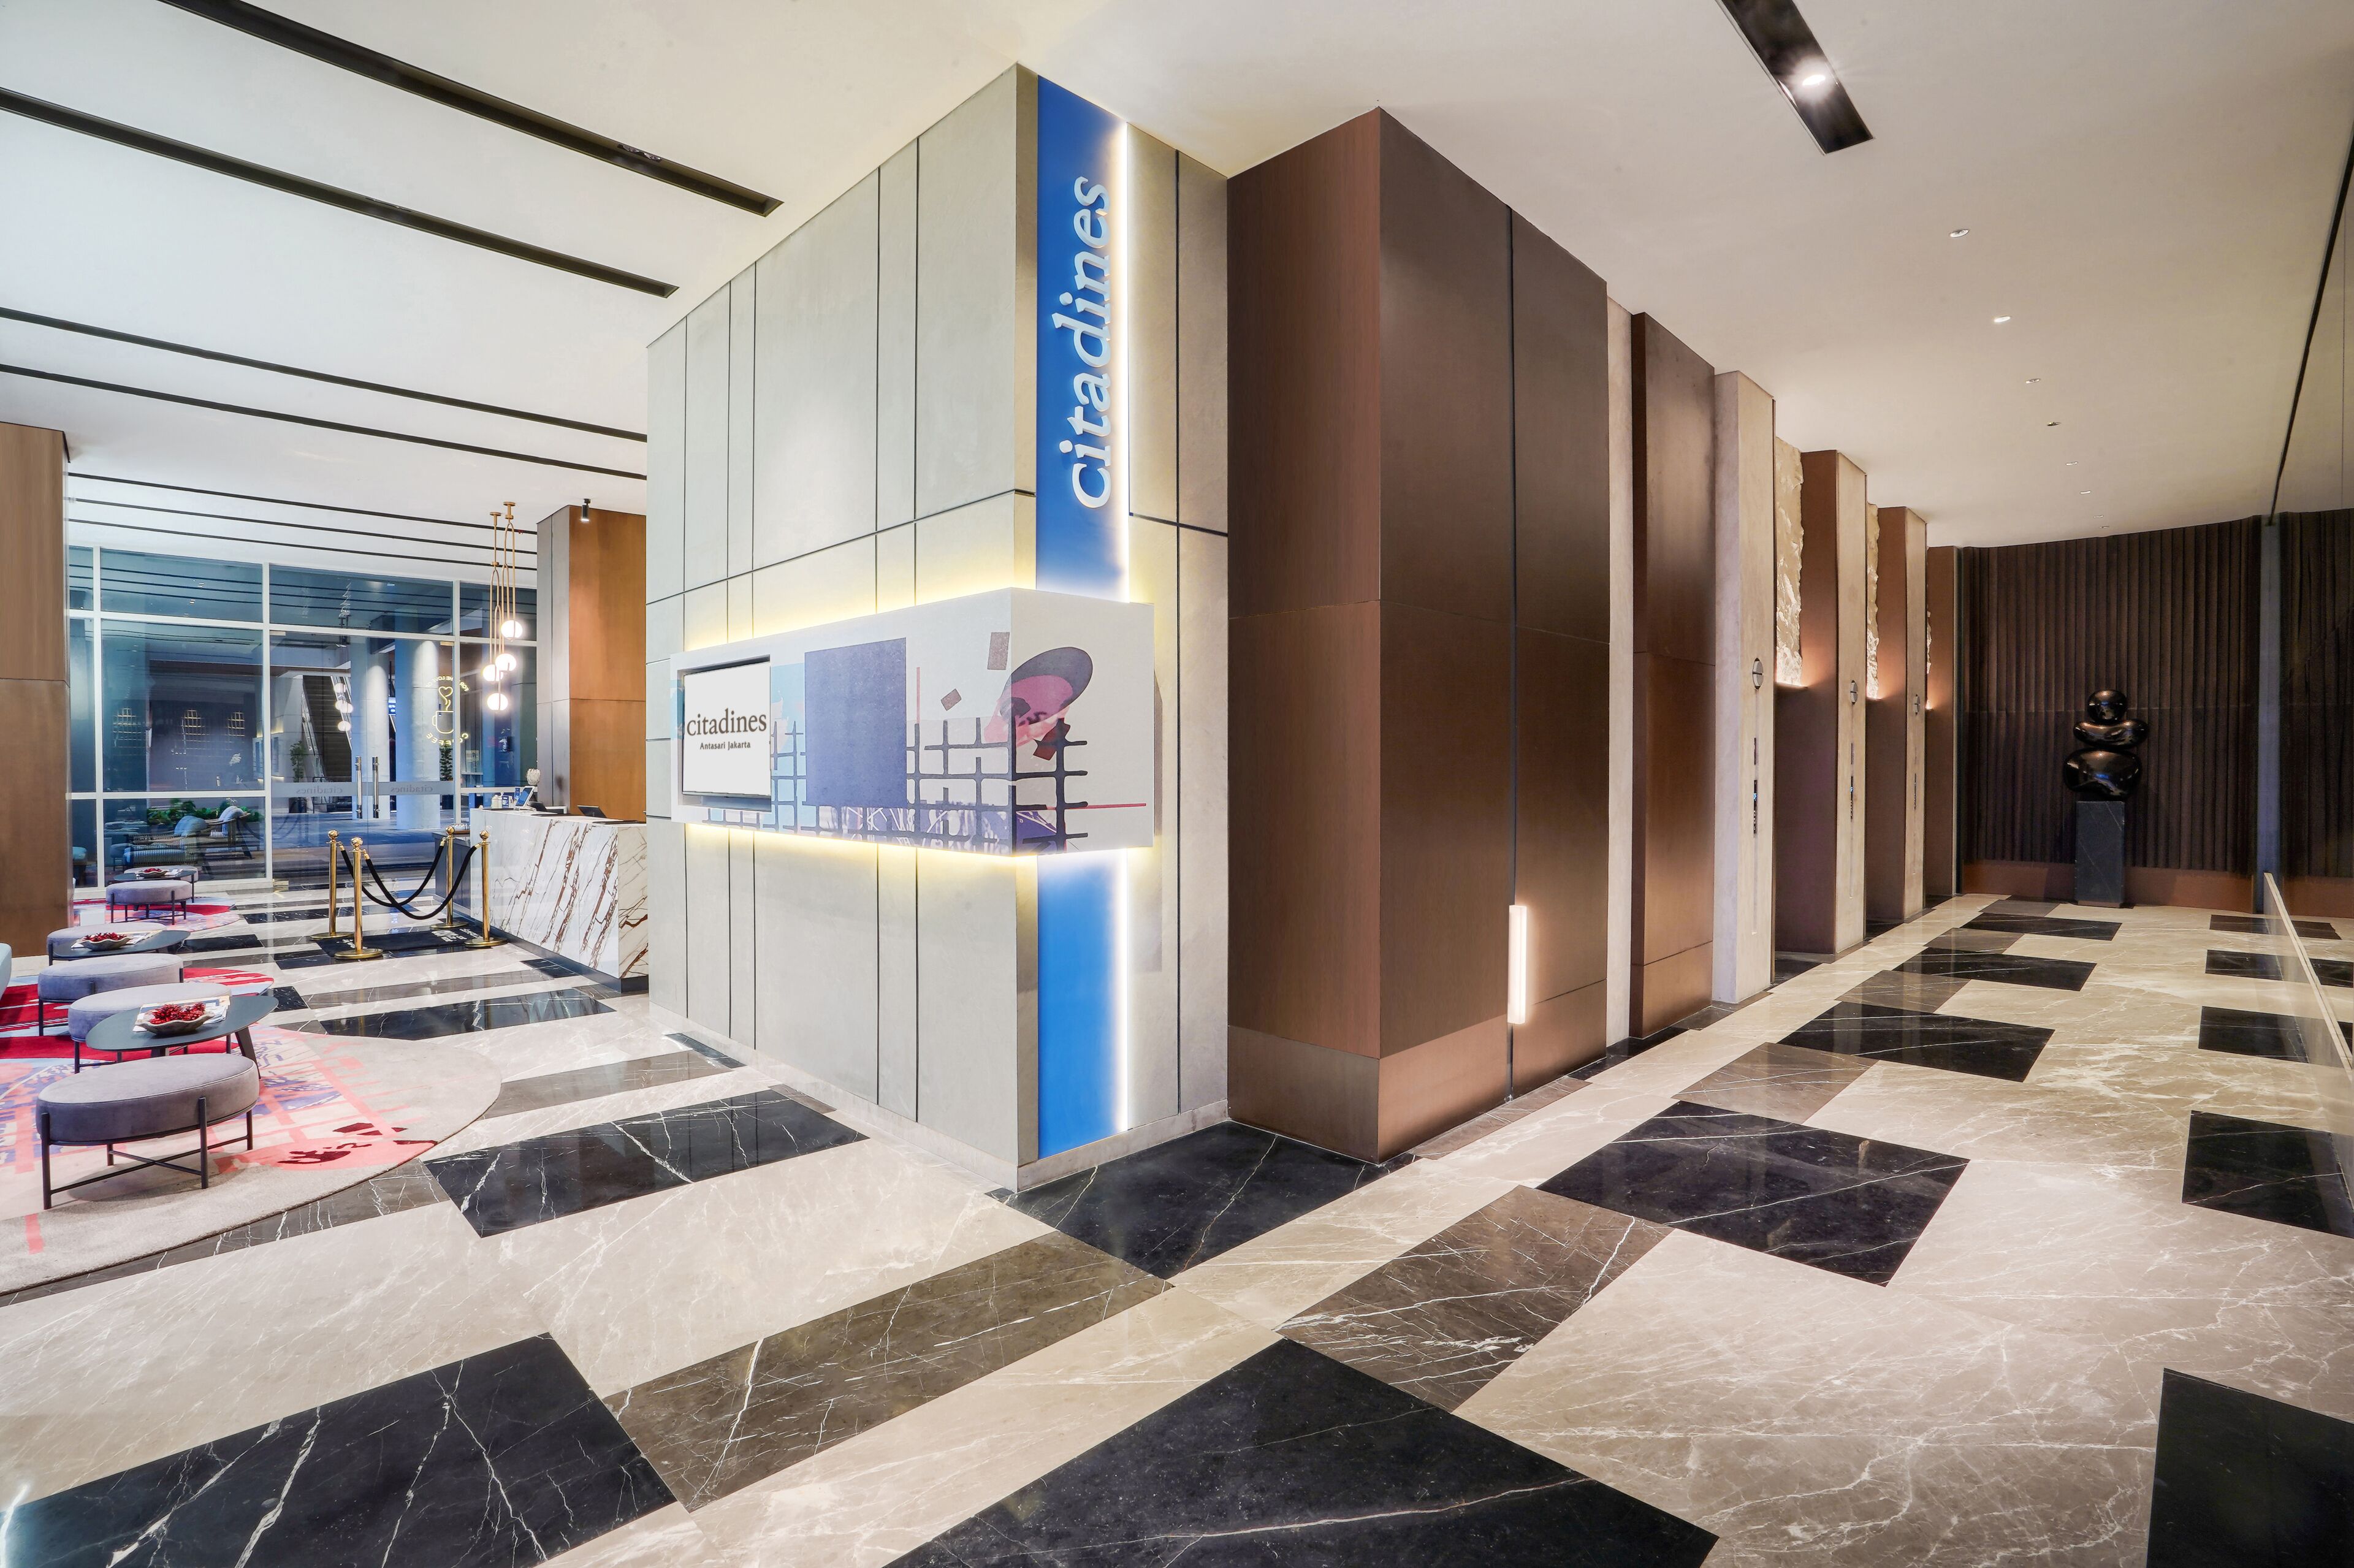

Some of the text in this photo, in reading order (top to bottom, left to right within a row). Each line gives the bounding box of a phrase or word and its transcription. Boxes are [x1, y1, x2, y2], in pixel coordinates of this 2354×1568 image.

[1051, 176, 1111, 508] citadines
[687, 708, 767, 736] citadines
[728, 741, 751, 750] Jakarta
